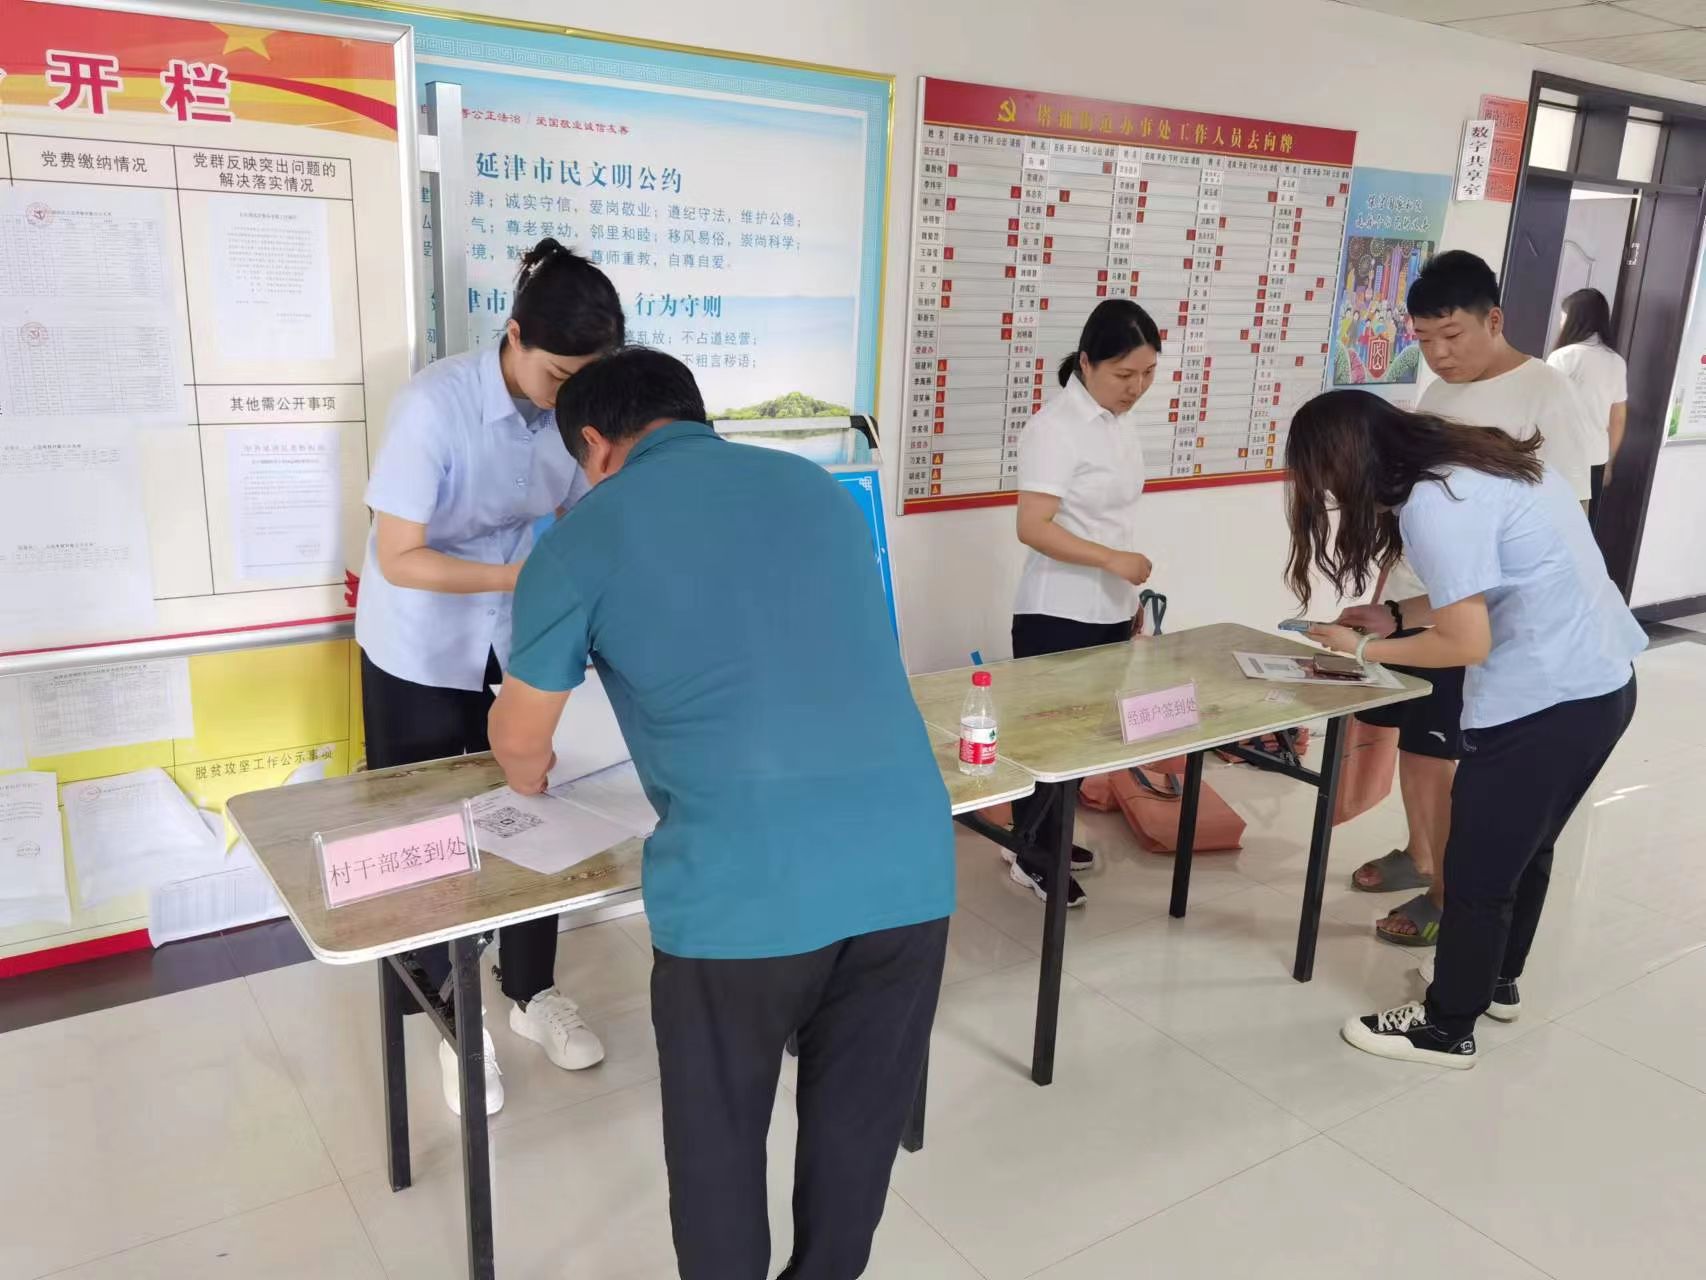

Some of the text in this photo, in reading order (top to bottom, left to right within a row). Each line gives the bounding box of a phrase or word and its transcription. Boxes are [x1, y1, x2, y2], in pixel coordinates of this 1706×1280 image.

[48, 51, 234, 123] 开栏
[40, 150, 148, 174] 党费缴纳情况
[192, 152, 337, 179] 党群反映突出问题的
[475, 152, 683, 194] 延津市民文明公约
[219, 171, 315, 194] 解决落实情况
[635, 291, 722, 318] 行为守则
[230, 395, 336, 412] 其他需公开事项
[195, 749, 334, 781] 脱贫攻坚工作公示事项
[327, 836, 467, 888] 村干部签到处
